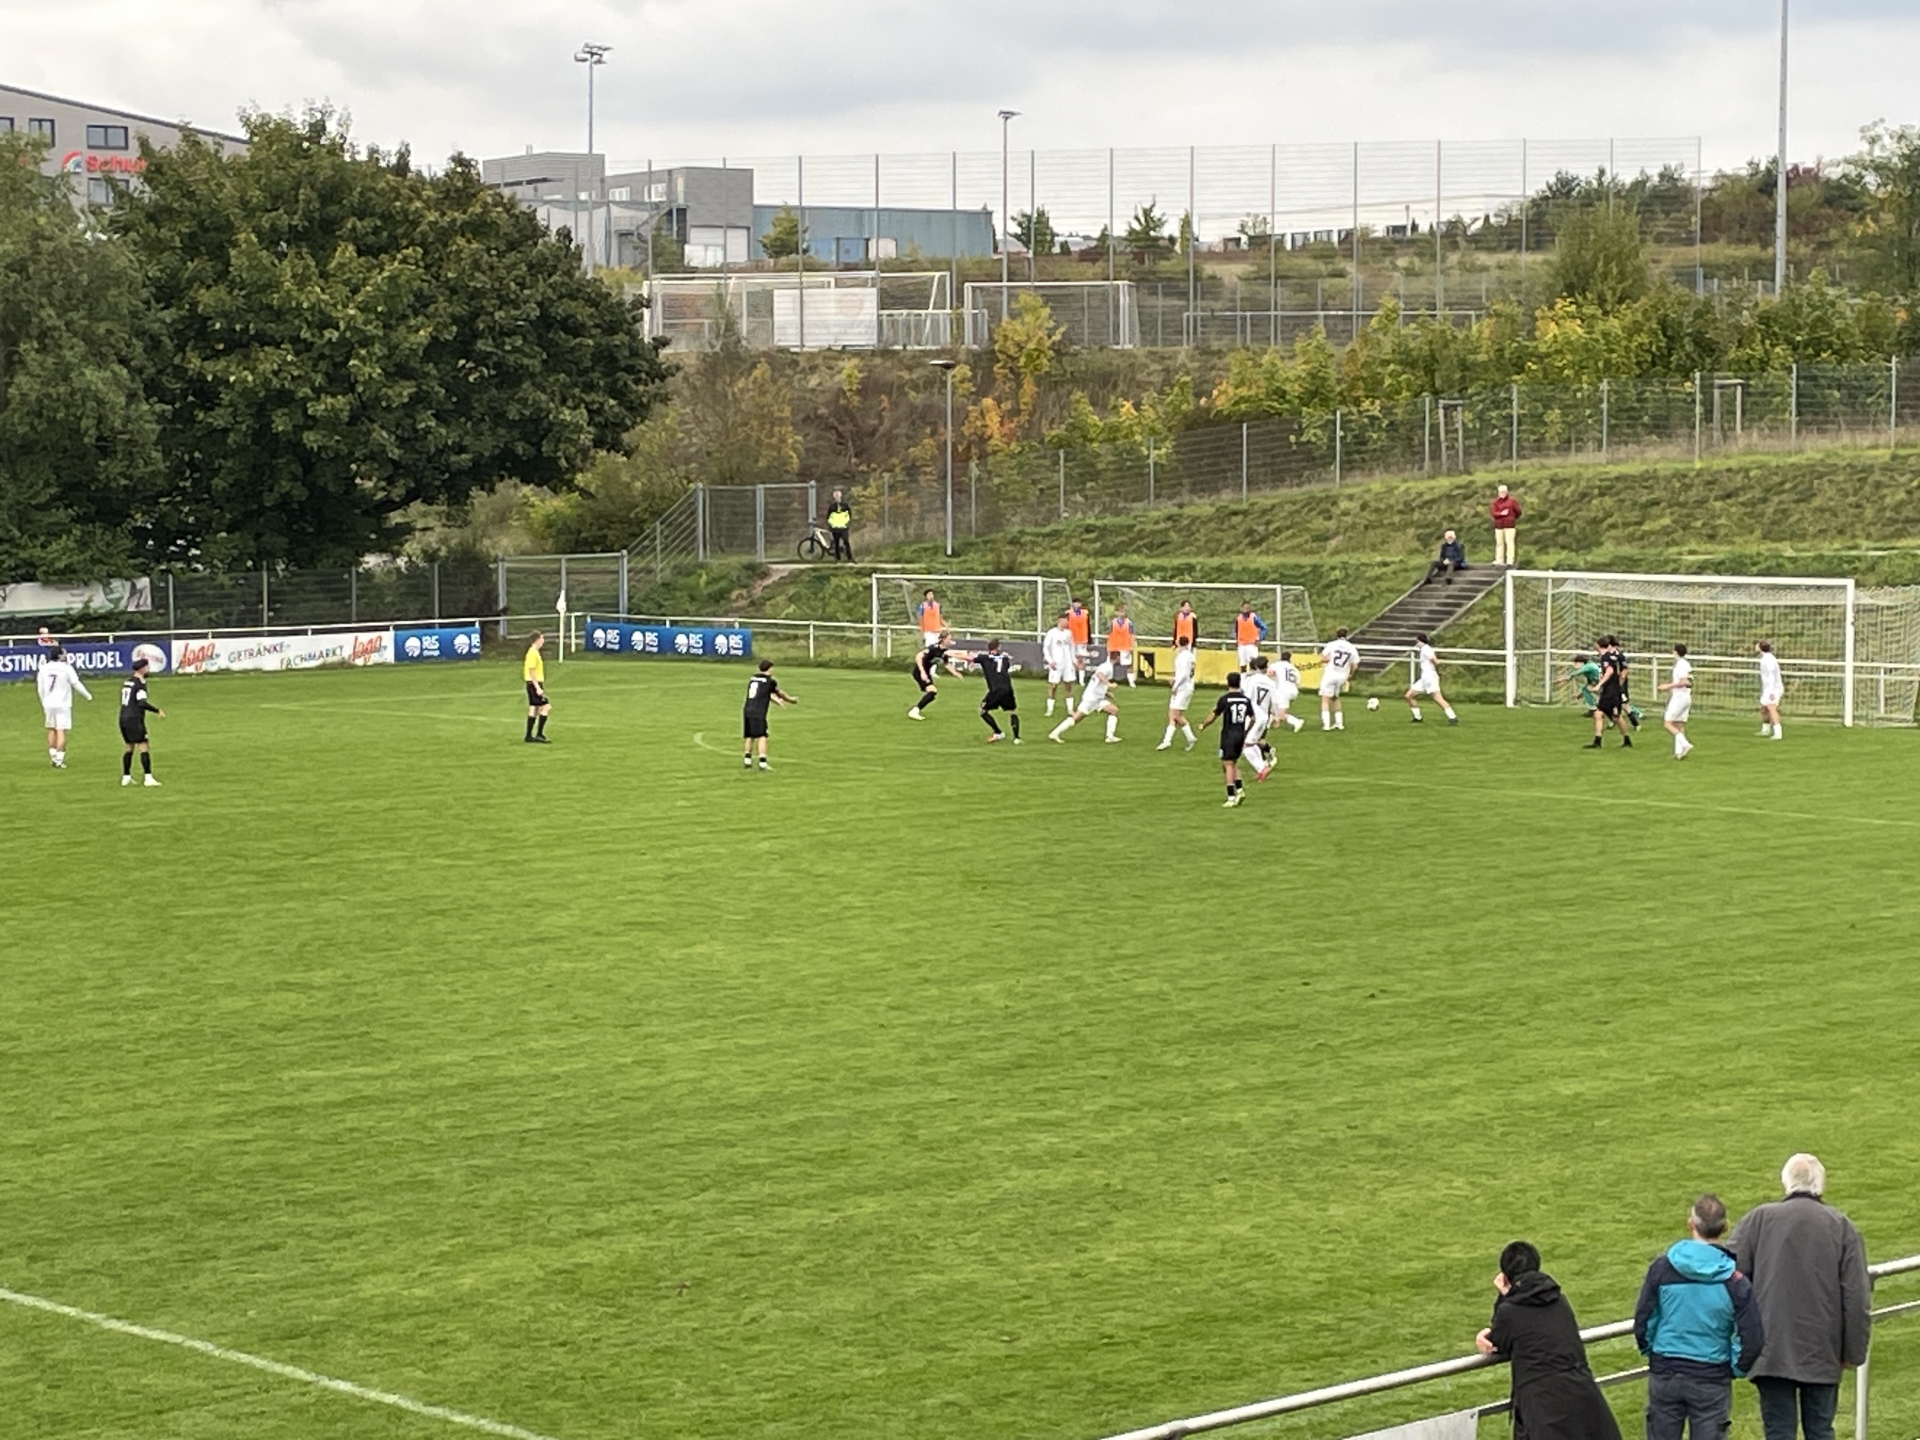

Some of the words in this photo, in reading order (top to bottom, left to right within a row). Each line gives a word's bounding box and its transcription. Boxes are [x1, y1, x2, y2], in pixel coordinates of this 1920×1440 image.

[66, 651, 123, 670] PRUDEL
[1333, 649, 1352, 668] 27
[48, 674, 58, 692] 7
[1230, 703, 1247, 724] 13
